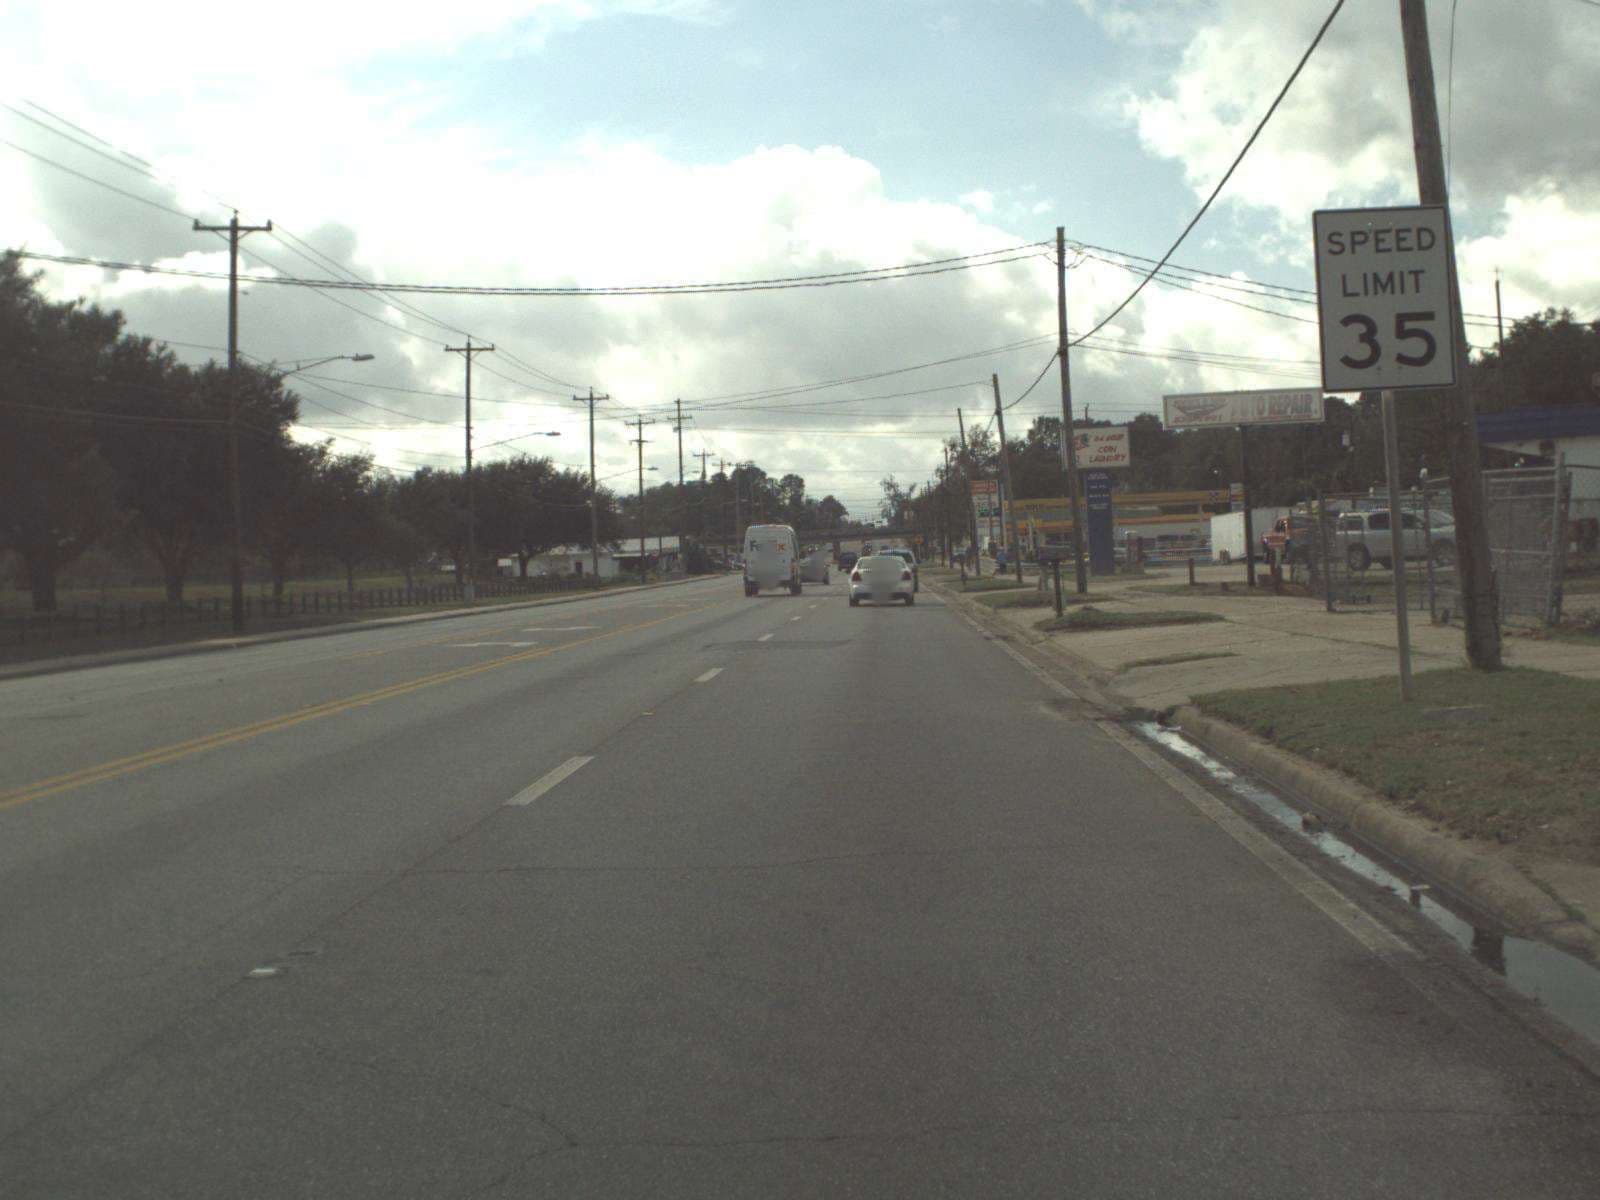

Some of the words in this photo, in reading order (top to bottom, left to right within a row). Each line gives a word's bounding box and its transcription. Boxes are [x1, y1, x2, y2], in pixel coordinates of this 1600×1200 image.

[1327, 227, 1436, 256] SPEED
[1342, 269, 1425, 297] LIMIT
[1339, 311, 1437, 369] 35
